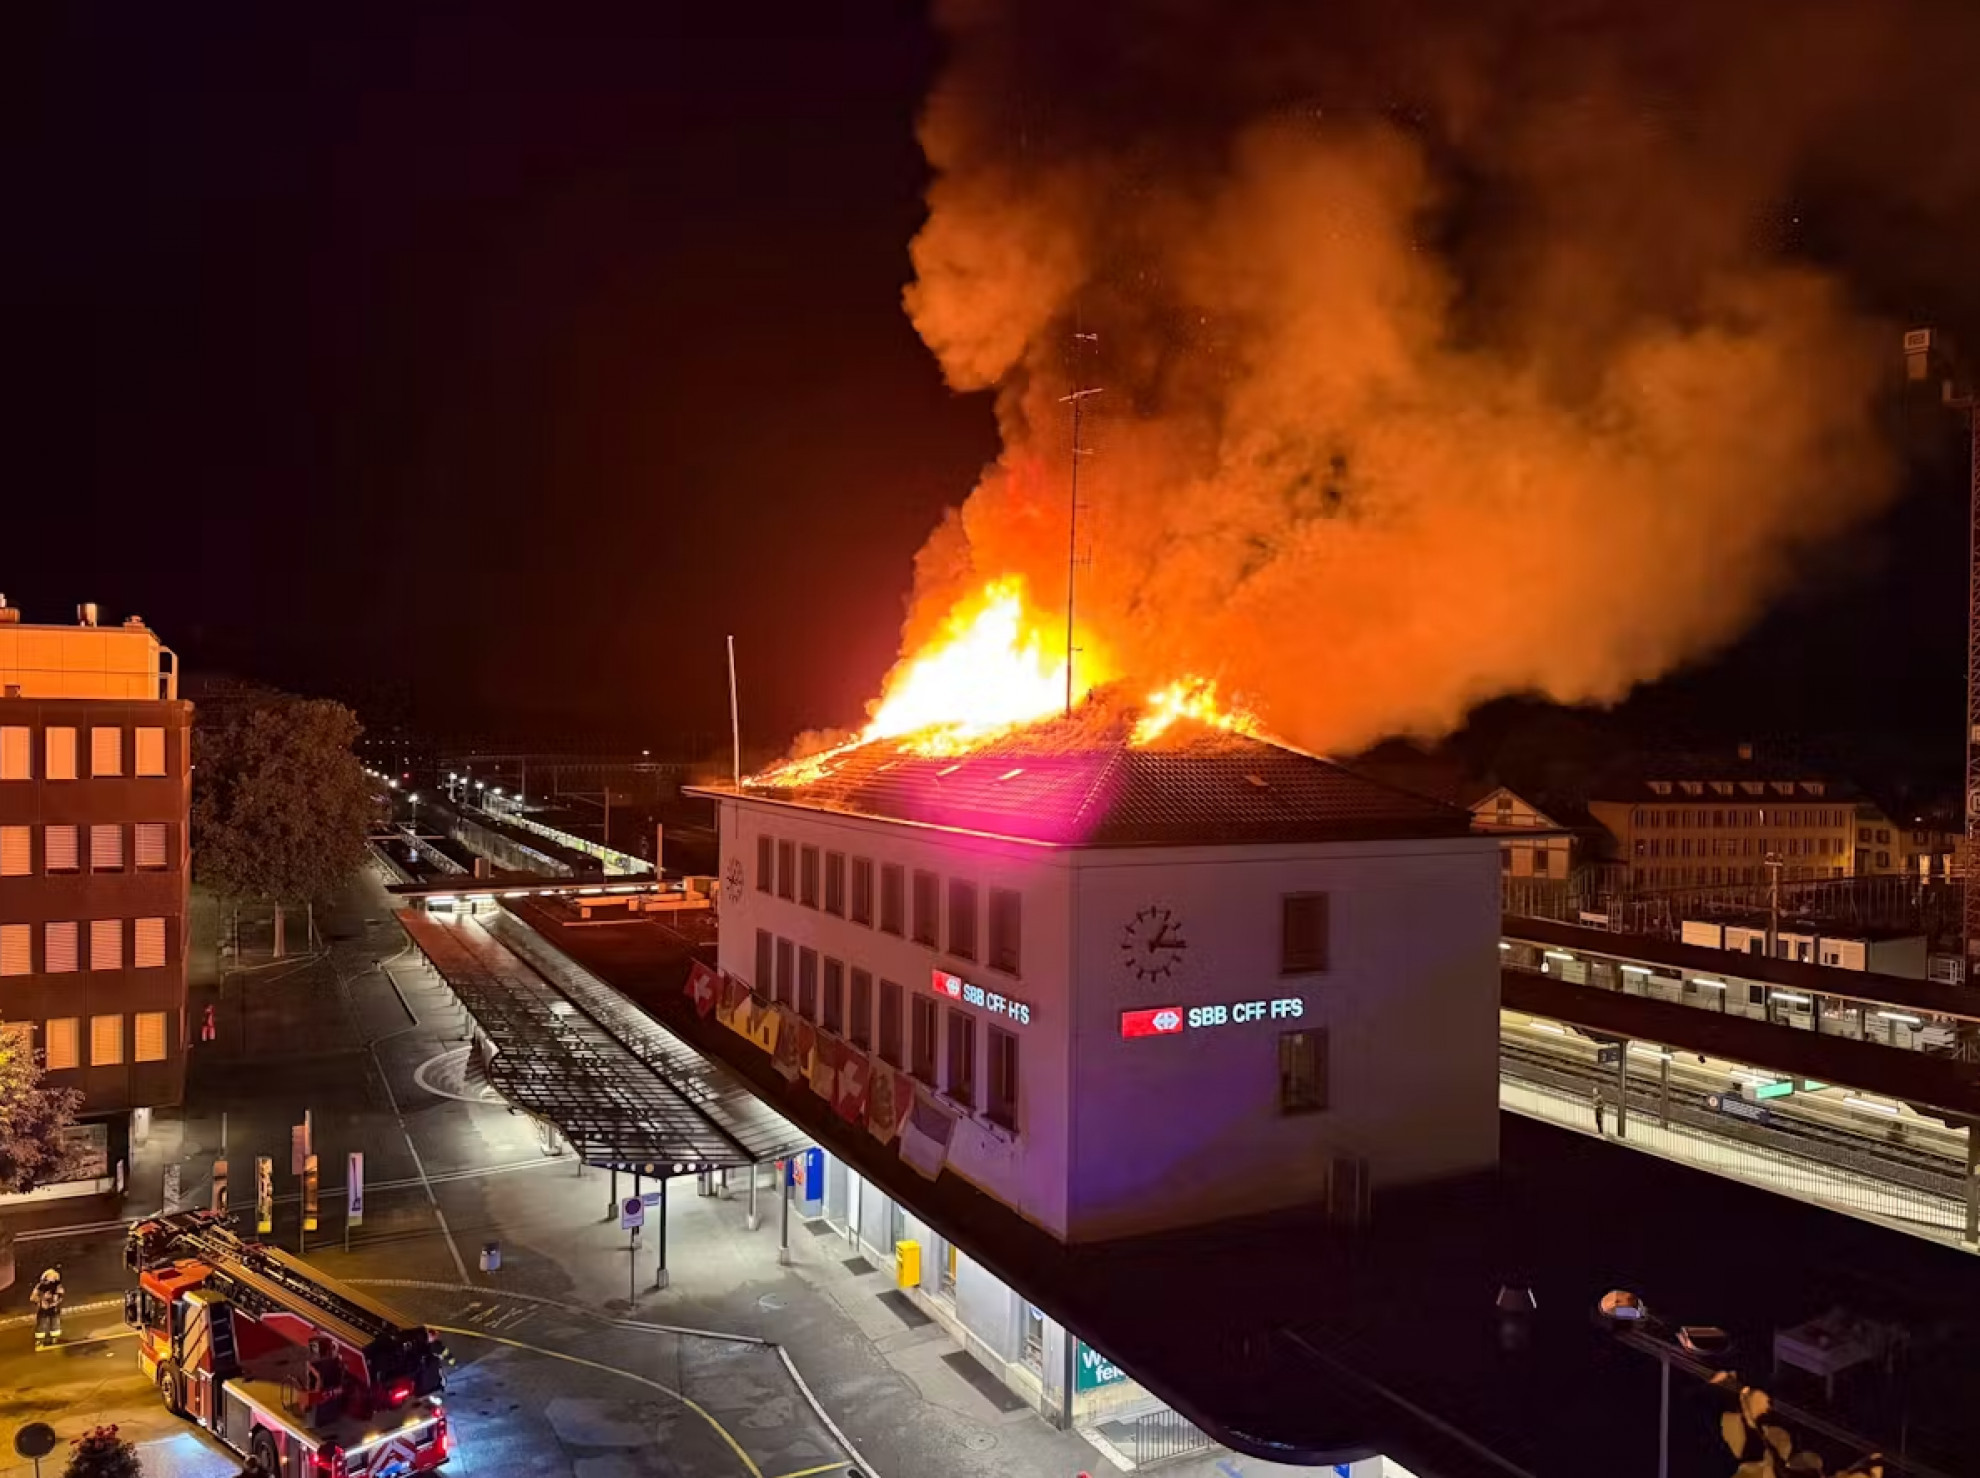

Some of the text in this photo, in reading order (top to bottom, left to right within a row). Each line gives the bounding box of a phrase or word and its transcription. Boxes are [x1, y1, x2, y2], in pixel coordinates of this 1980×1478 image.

[963, 983, 985, 1007] SBB
[986, 992, 1007, 1014] CFF
[1188, 998, 1304, 1028] SBB CFF FFS
